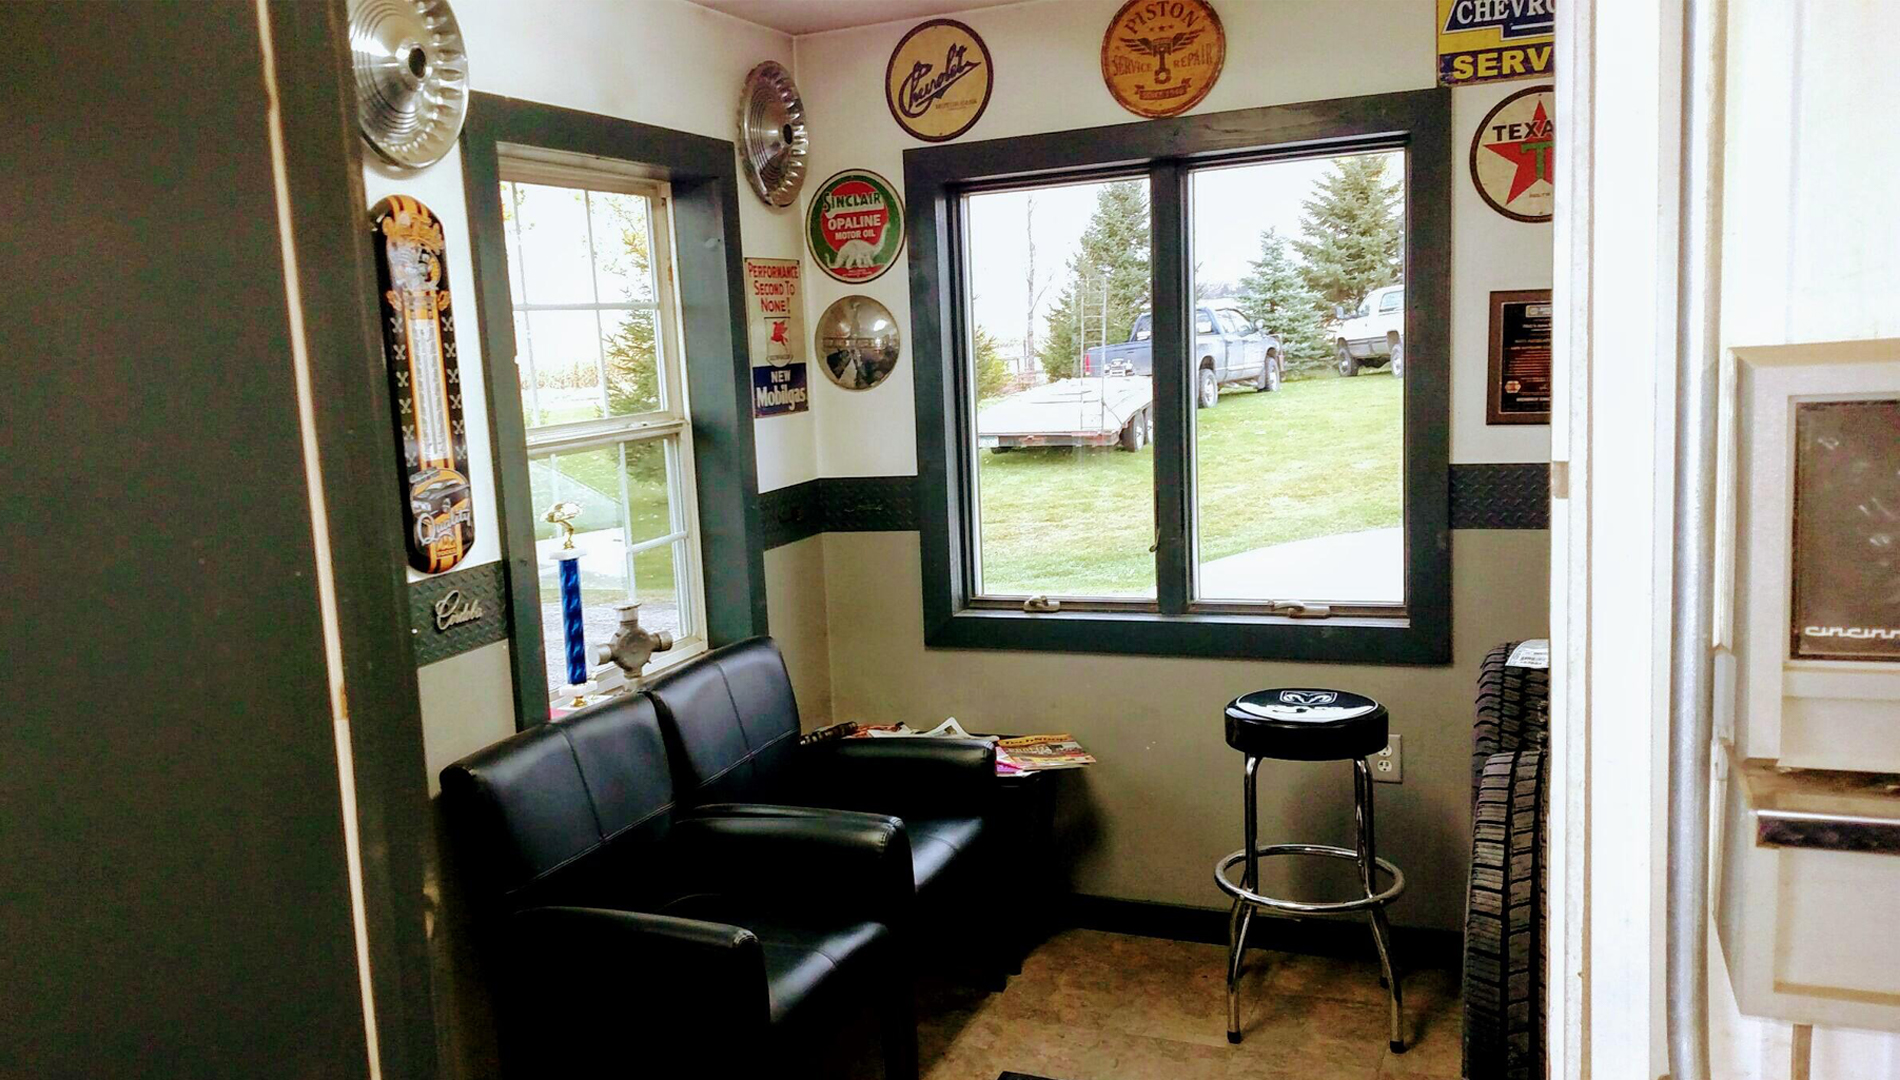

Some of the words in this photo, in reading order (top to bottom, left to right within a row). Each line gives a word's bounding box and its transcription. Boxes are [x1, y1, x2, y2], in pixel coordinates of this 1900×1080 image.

[1124, 1, 1200, 34] PISTON
[1112, 55, 1152, 76] SERVICE
[1173, 43, 1213, 68] REPAIR
[1453, 46, 1552, 79] SERV
[823, 191, 881, 212] SINCLAIR
[828, 214, 881, 231] OPALINE
[835, 230, 861, 240] MOTOR
[863, 229, 876, 238] OIL
[748, 262, 799, 279] PERFORMANCE
[771, 370, 792, 384] NEW
[756, 382, 806, 411] Mobilgas
[417, 509, 471, 546] Quality
